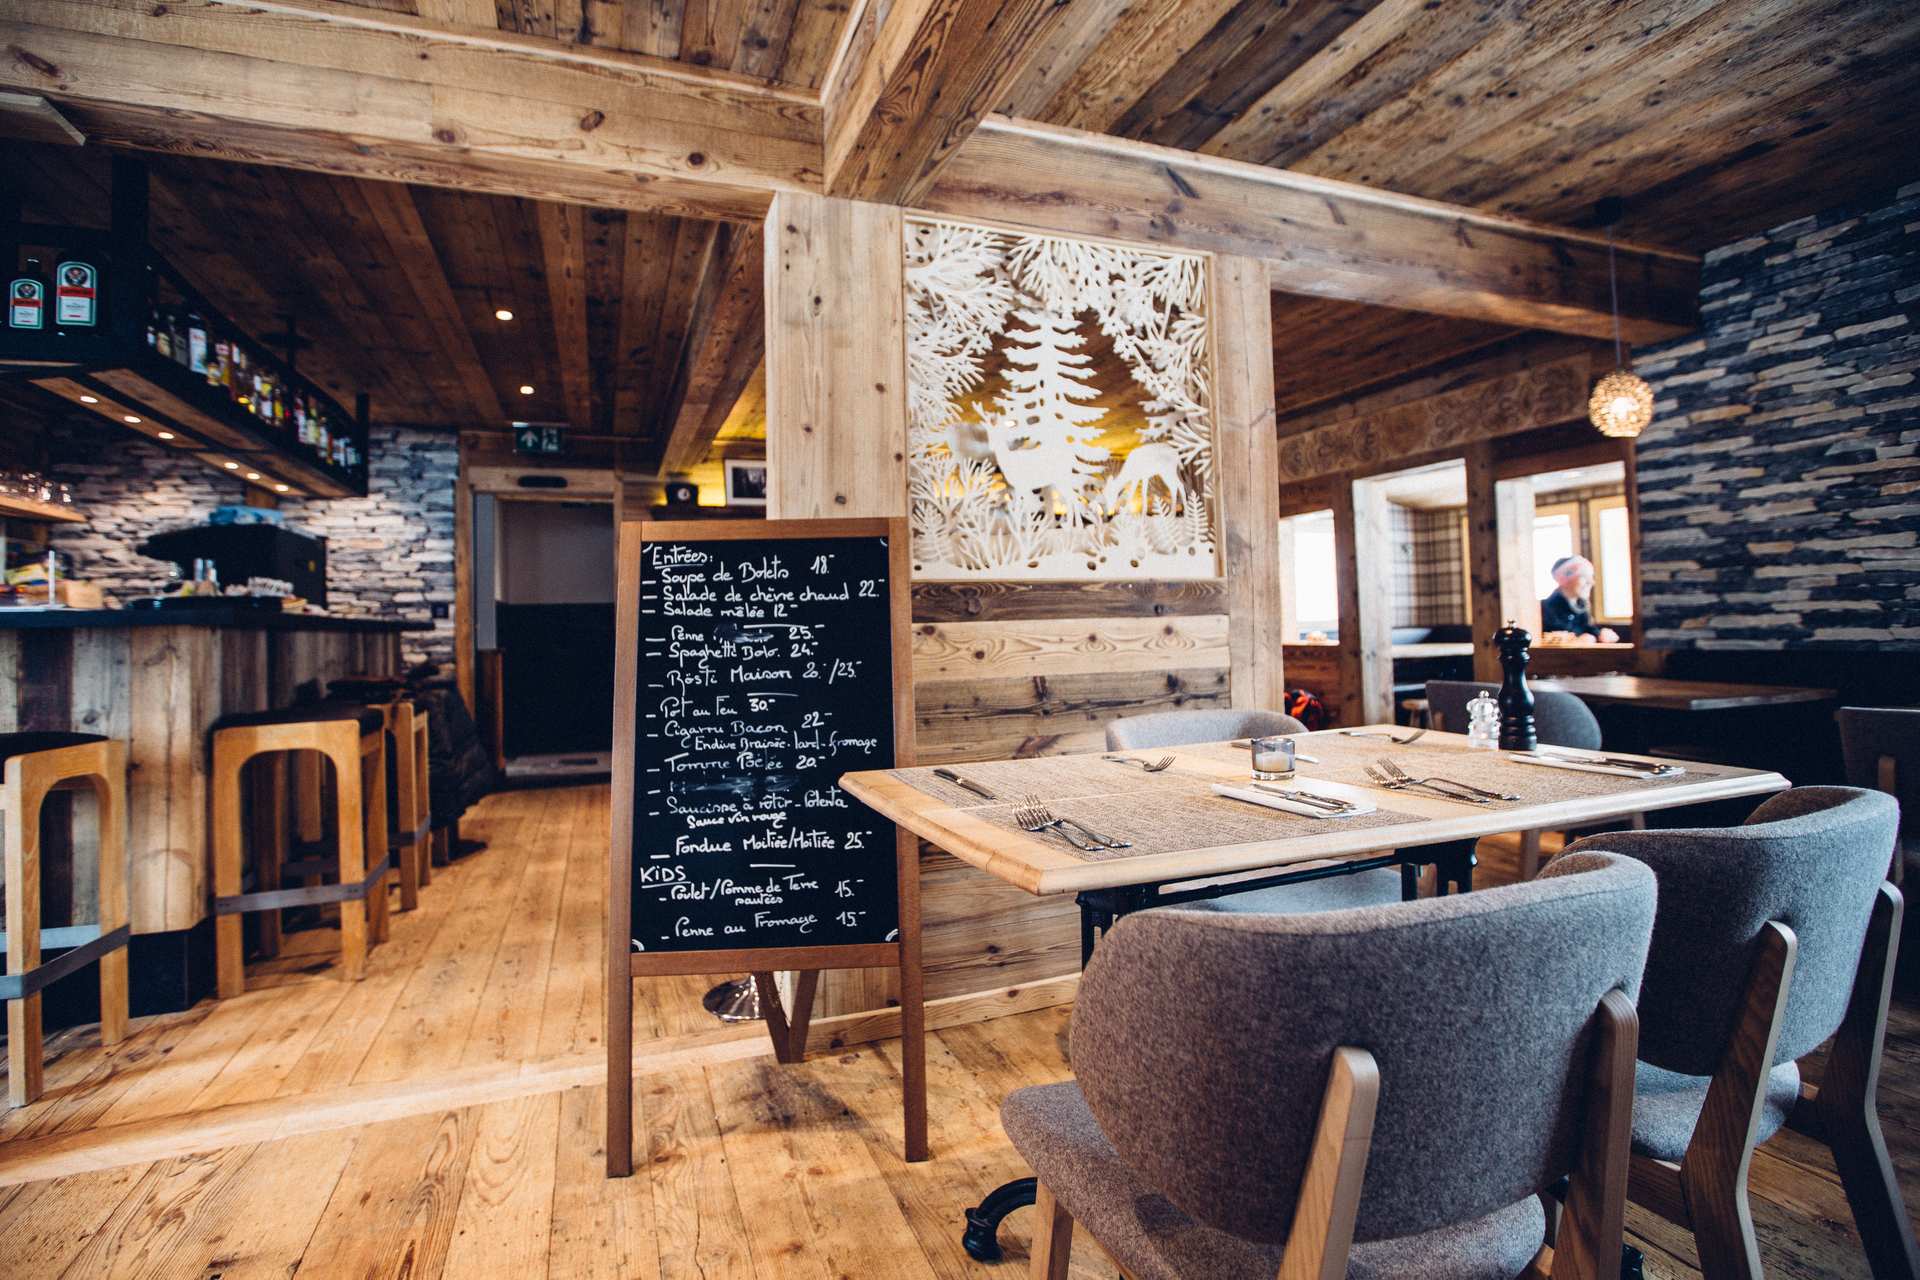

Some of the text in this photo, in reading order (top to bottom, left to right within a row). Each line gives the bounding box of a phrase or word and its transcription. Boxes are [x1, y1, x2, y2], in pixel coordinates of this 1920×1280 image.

[653, 545, 713, 566] Entrées:
[661, 568, 706, 595] Soupe
[712, 561, 733, 581] de
[738, 554, 789, 583] Bolets
[663, 584, 717, 602] Salade
[724, 585, 743, 602] de
[750, 584, 795, 603] chèvre
[799, 582, 849, 602] chaud
[663, 601, 713, 616] Salade
[671, 624, 704, 641] Penne
[668, 641, 737, 669] Spaghetti
[730, 664, 792, 683] Maison
[659, 696, 693, 718] Pot
[692, 708, 711, 717] au
[716, 695, 738, 716] Feu
[730, 720, 788, 737] Bacon
[695, 735, 736, 751] Endive
[828, 730, 878, 757] fromage
[664, 752, 731, 773] Tomme
[666, 796, 738, 815] Saucisse
[742, 797, 754, 811] à
[759, 792, 793, 809] rôtir
[804, 785, 849, 809] Polenta
[686, 814, 725, 829] Sauce
[752, 811, 787, 829] rouge
[675, 835, 732, 856] Fondue
[765, 877, 782, 893] de
[782, 872, 819, 891] Terre
[735, 893, 784, 906] sautées
[674, 916, 714, 937] Penne
[724, 925, 746, 934] au
[754, 911, 818, 934] Fromage
